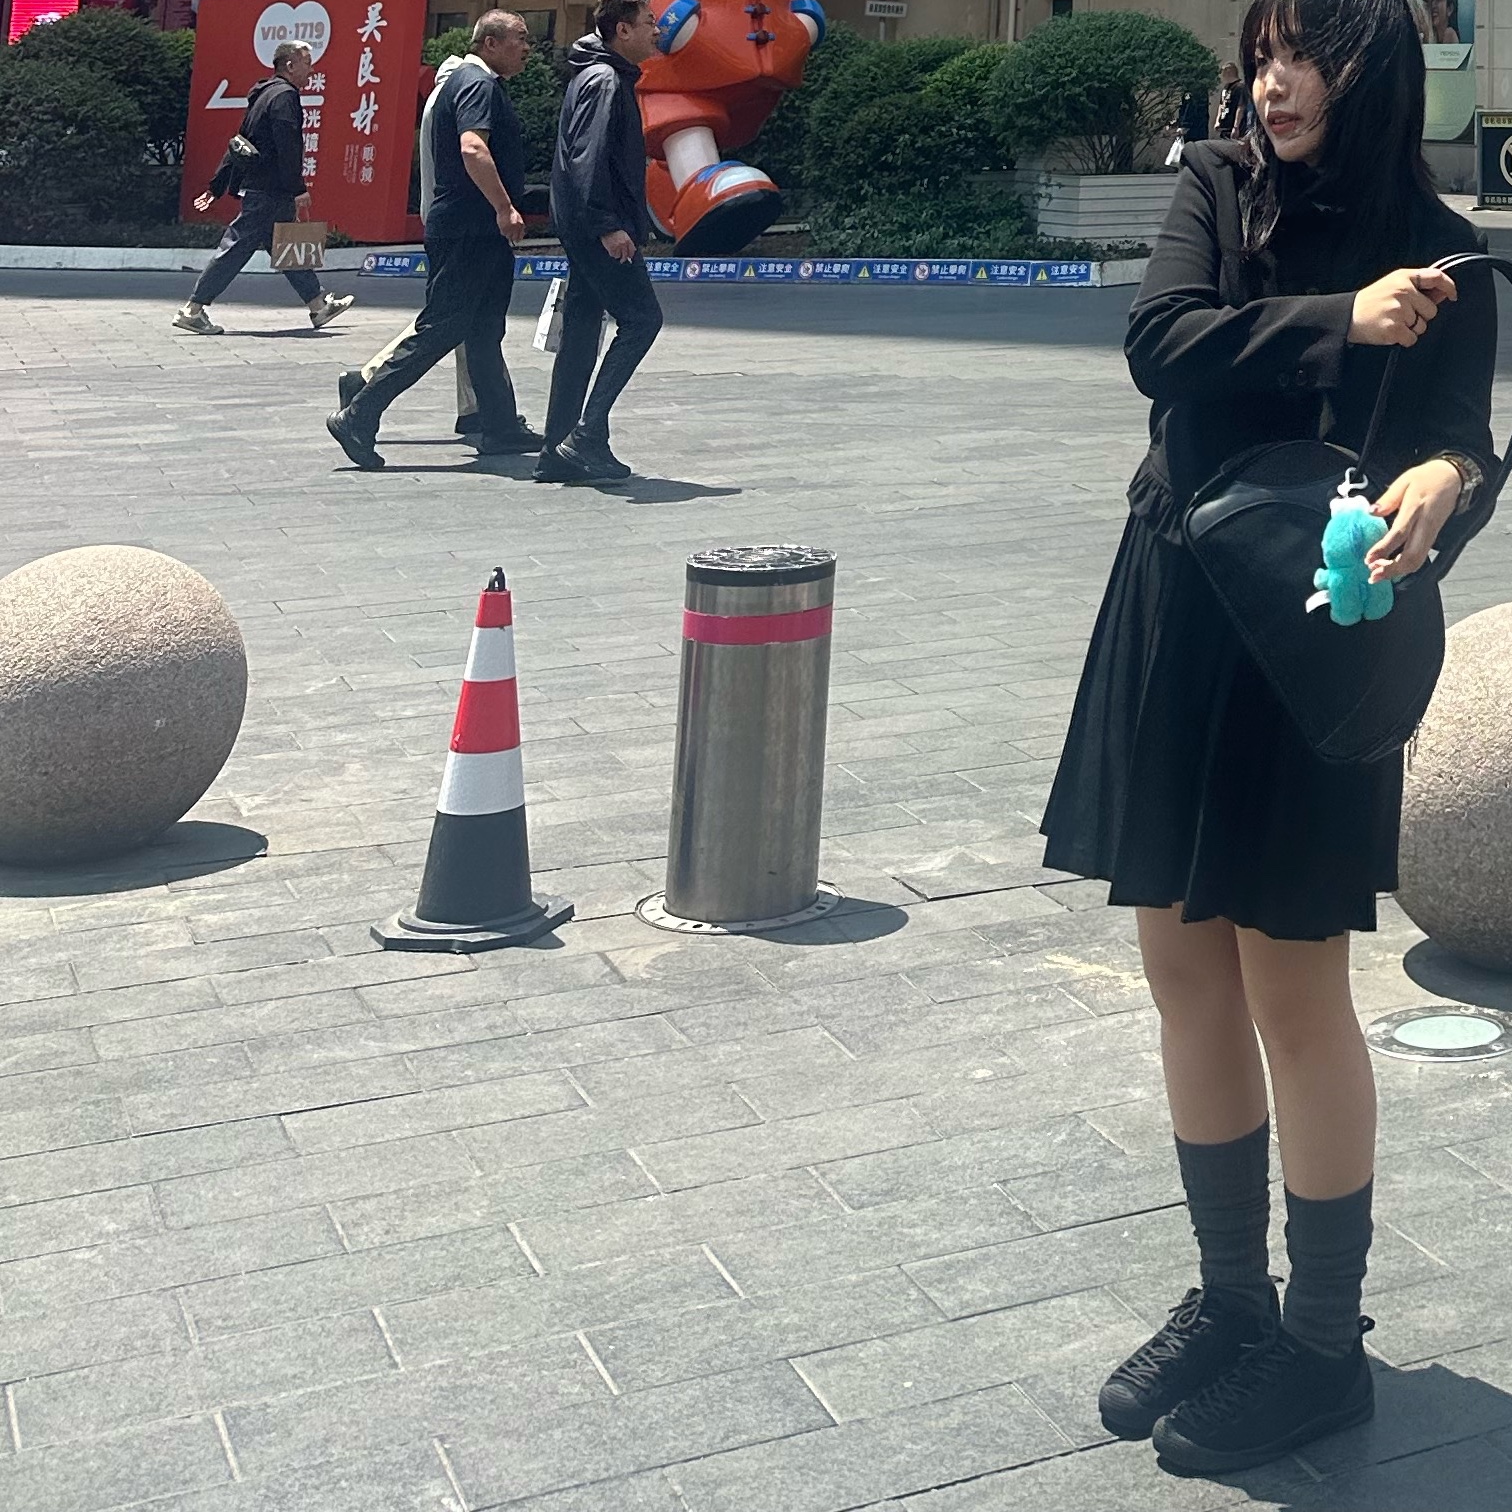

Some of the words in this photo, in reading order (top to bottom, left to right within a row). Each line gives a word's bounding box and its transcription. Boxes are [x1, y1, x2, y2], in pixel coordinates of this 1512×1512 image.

[989, 264, 1027, 276] 注意安全
[1050, 264, 1088, 275] 注意安全
